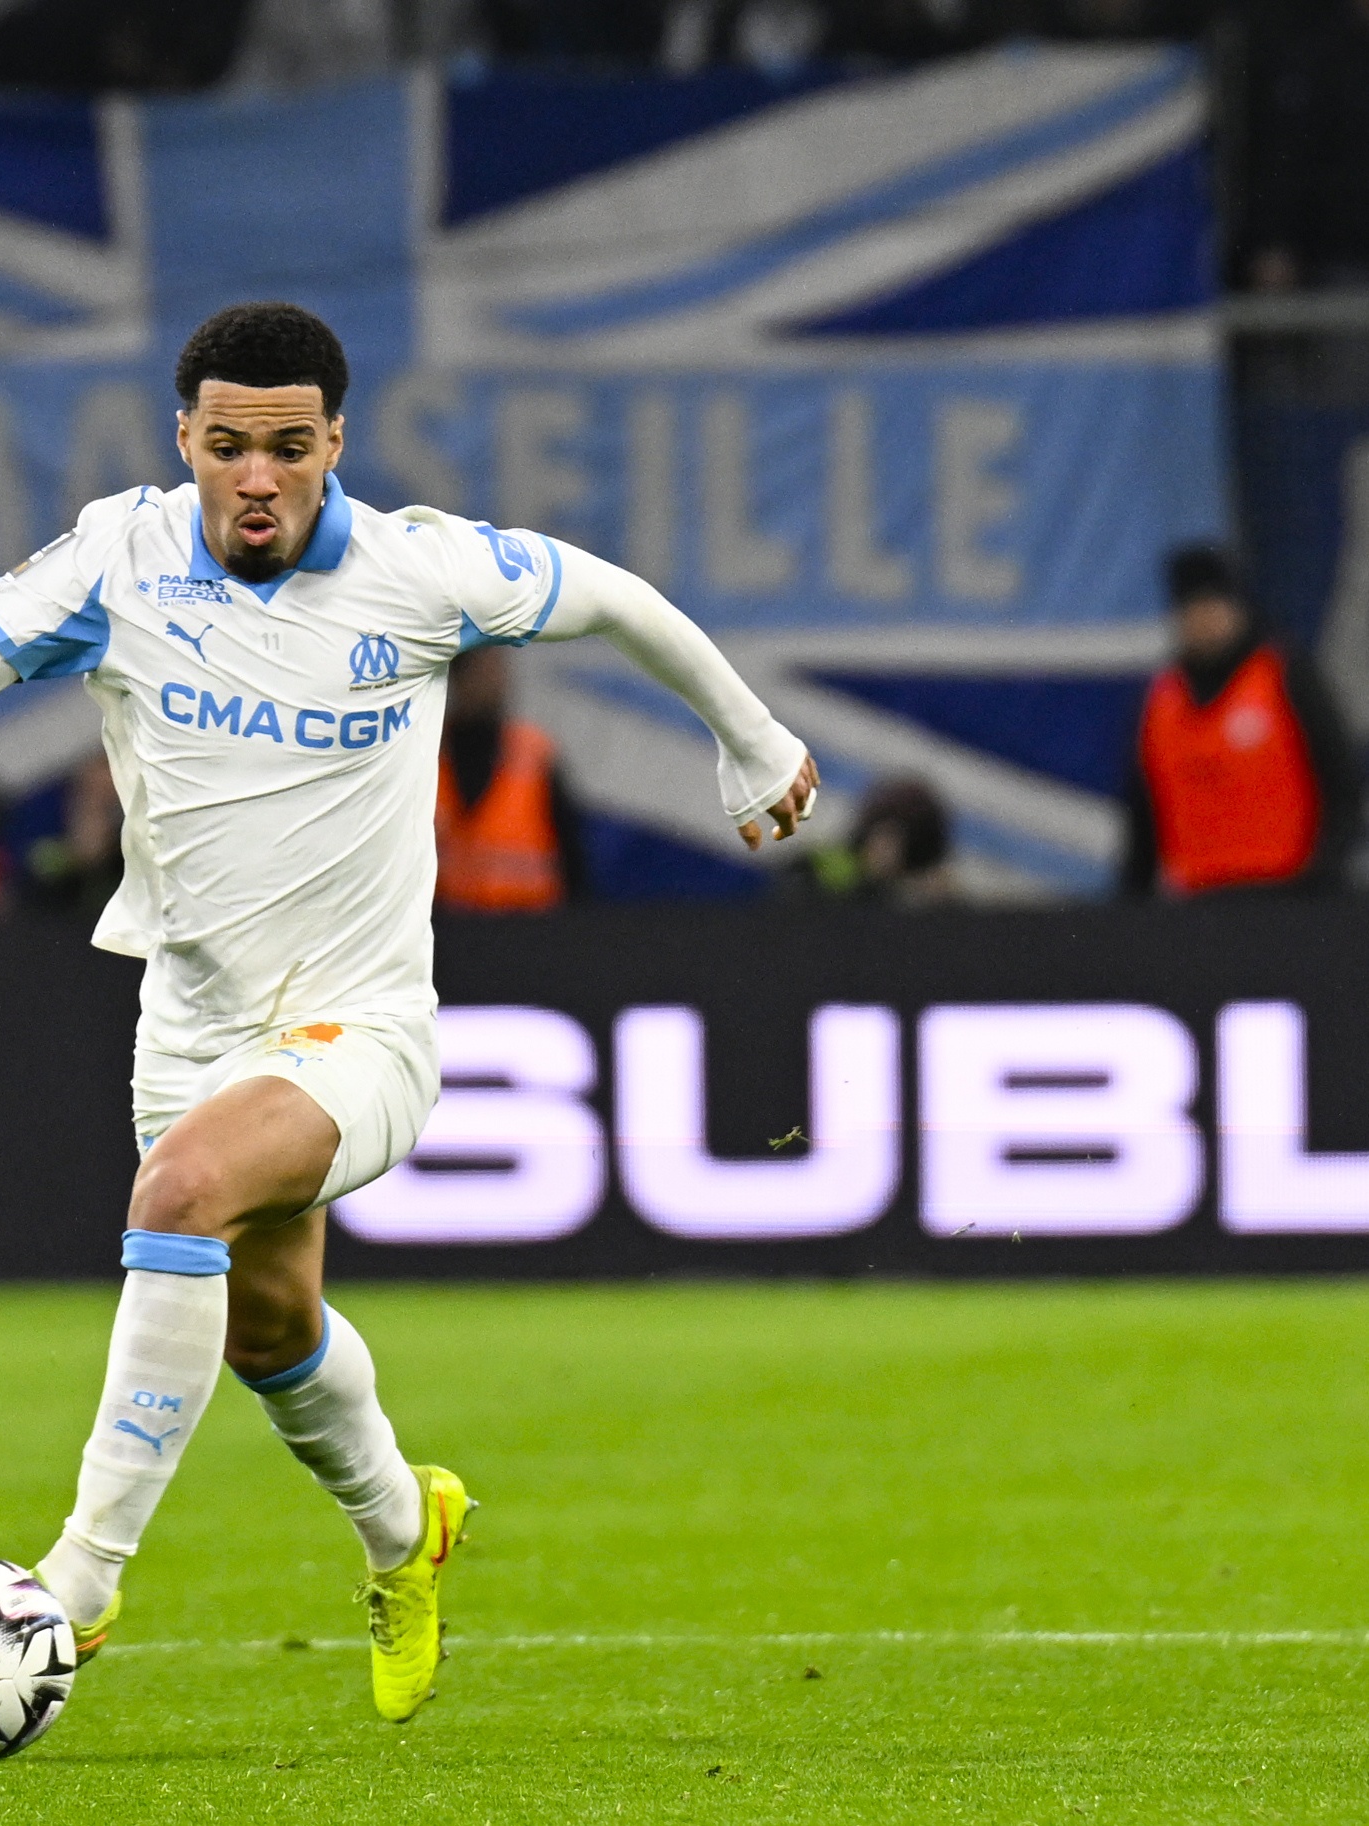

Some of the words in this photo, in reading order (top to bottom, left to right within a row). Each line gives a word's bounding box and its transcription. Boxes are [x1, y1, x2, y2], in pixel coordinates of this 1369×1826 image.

[260, 632, 280, 651] 11
[160, 681, 284, 744] CMA
[295, 696, 412, 750] CGM
[132, 1390, 183, 1412] OM
